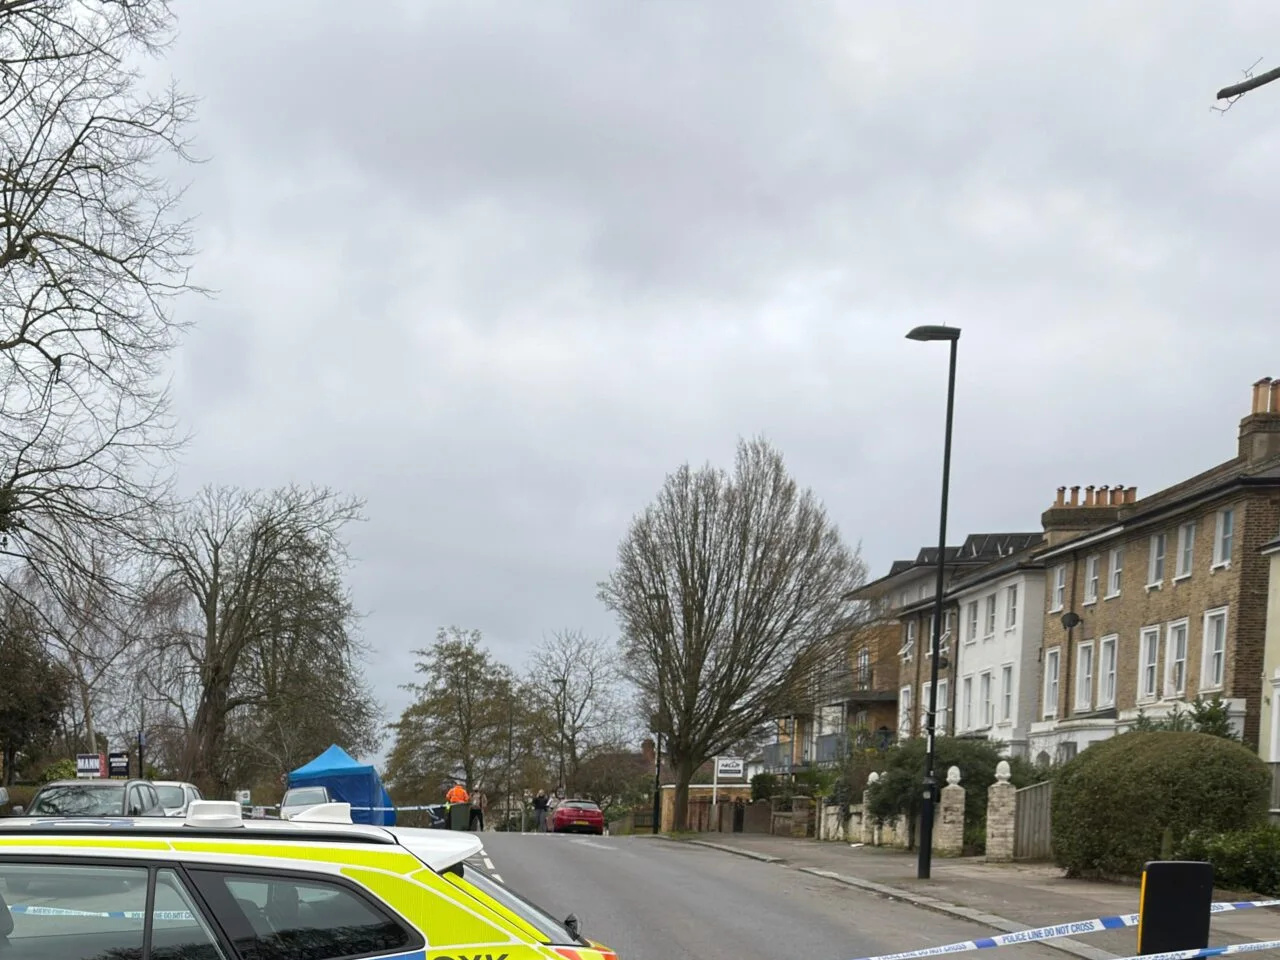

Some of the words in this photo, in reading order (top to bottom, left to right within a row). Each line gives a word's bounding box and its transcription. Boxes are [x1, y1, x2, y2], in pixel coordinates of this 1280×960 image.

[1002, 934, 1027, 944] POLICE
[1028, 929, 1044, 941] LINE
[1044, 927, 1055, 938] DO
[1055, 924, 1070, 937] NOT
[1070, 921, 1095, 934] CROSS
